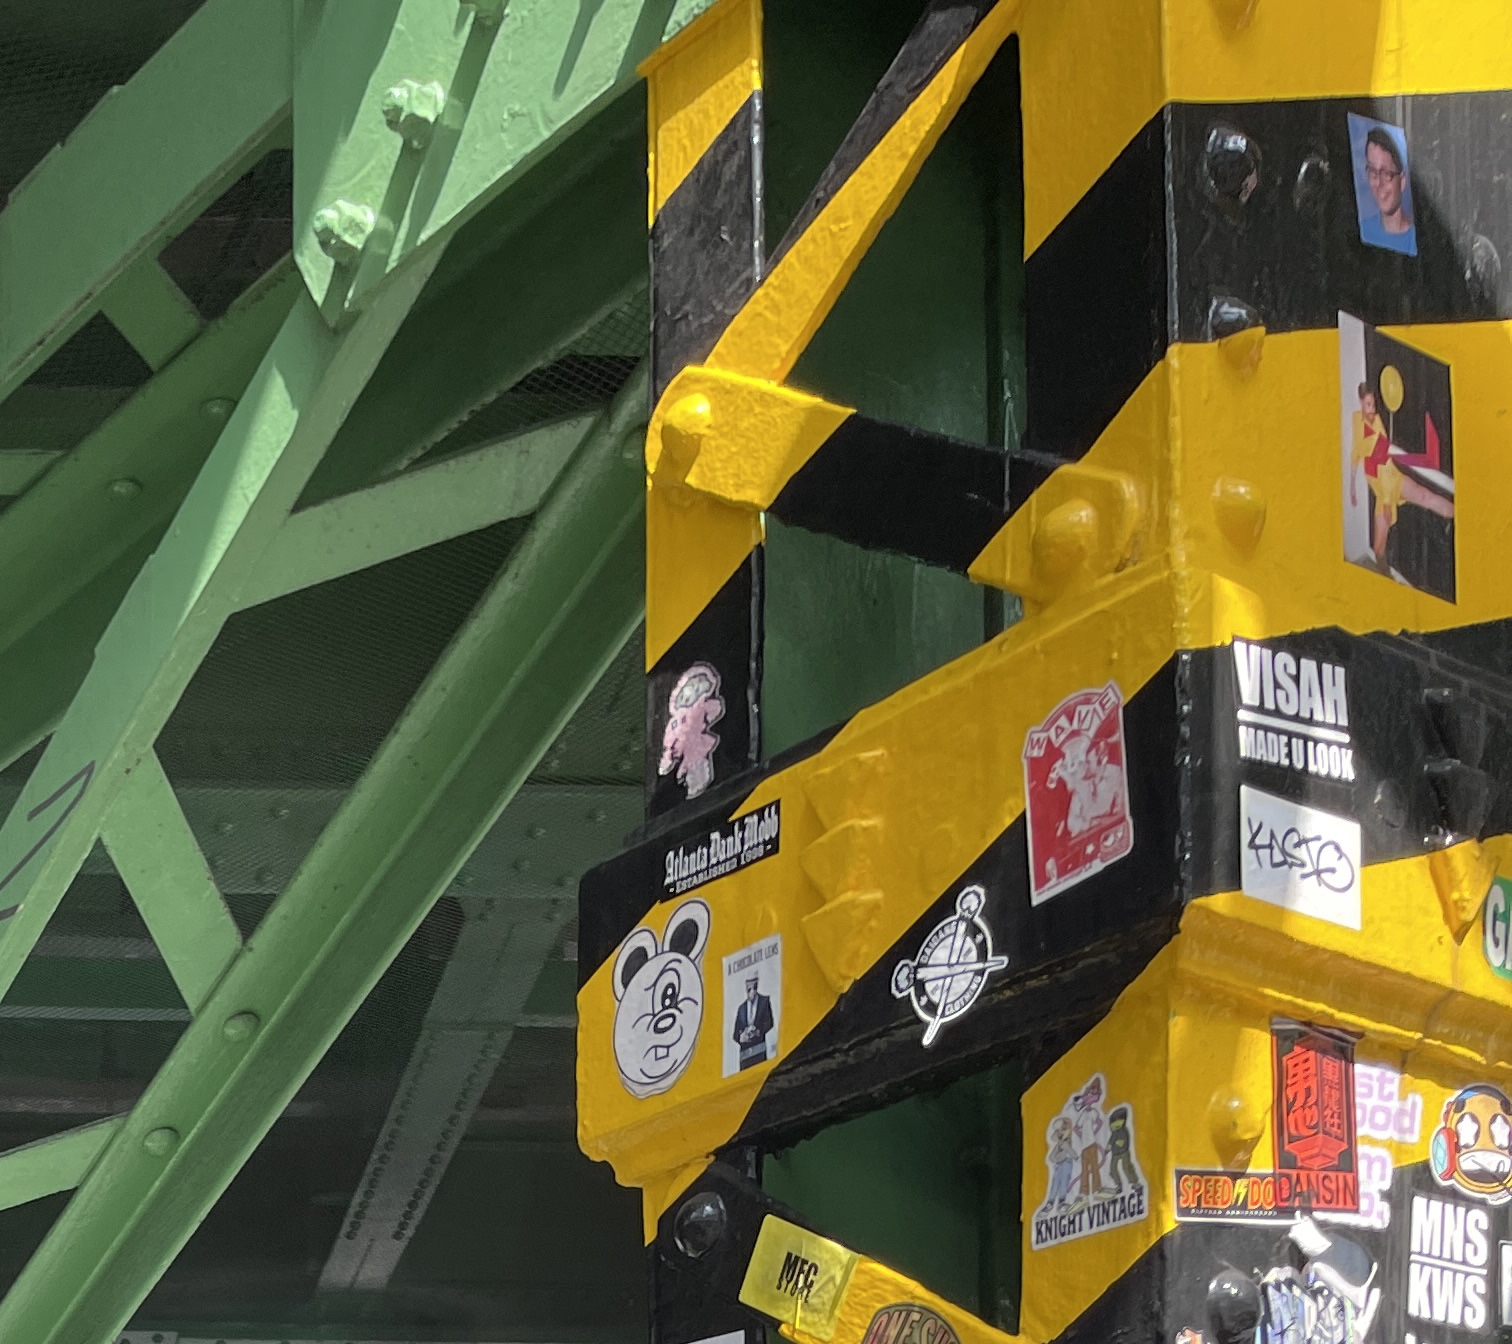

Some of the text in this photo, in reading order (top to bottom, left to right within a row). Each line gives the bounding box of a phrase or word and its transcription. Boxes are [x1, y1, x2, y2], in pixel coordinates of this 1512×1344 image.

[1234, 640, 1349, 728] VISAH
[1239, 725, 1355, 782] MADE U LOOK
[664, 805, 779, 886] Atlanta Dank Mobb
[1035, 1192, 1145, 1246] KNIGHT VINTAGE
[1179, 1175, 1234, 1209] SPEED
[1278, 1171, 1357, 1209] DANSIN
[1412, 1197, 1488, 1266] MNS
[1407, 1262, 1486, 1330] KWS
